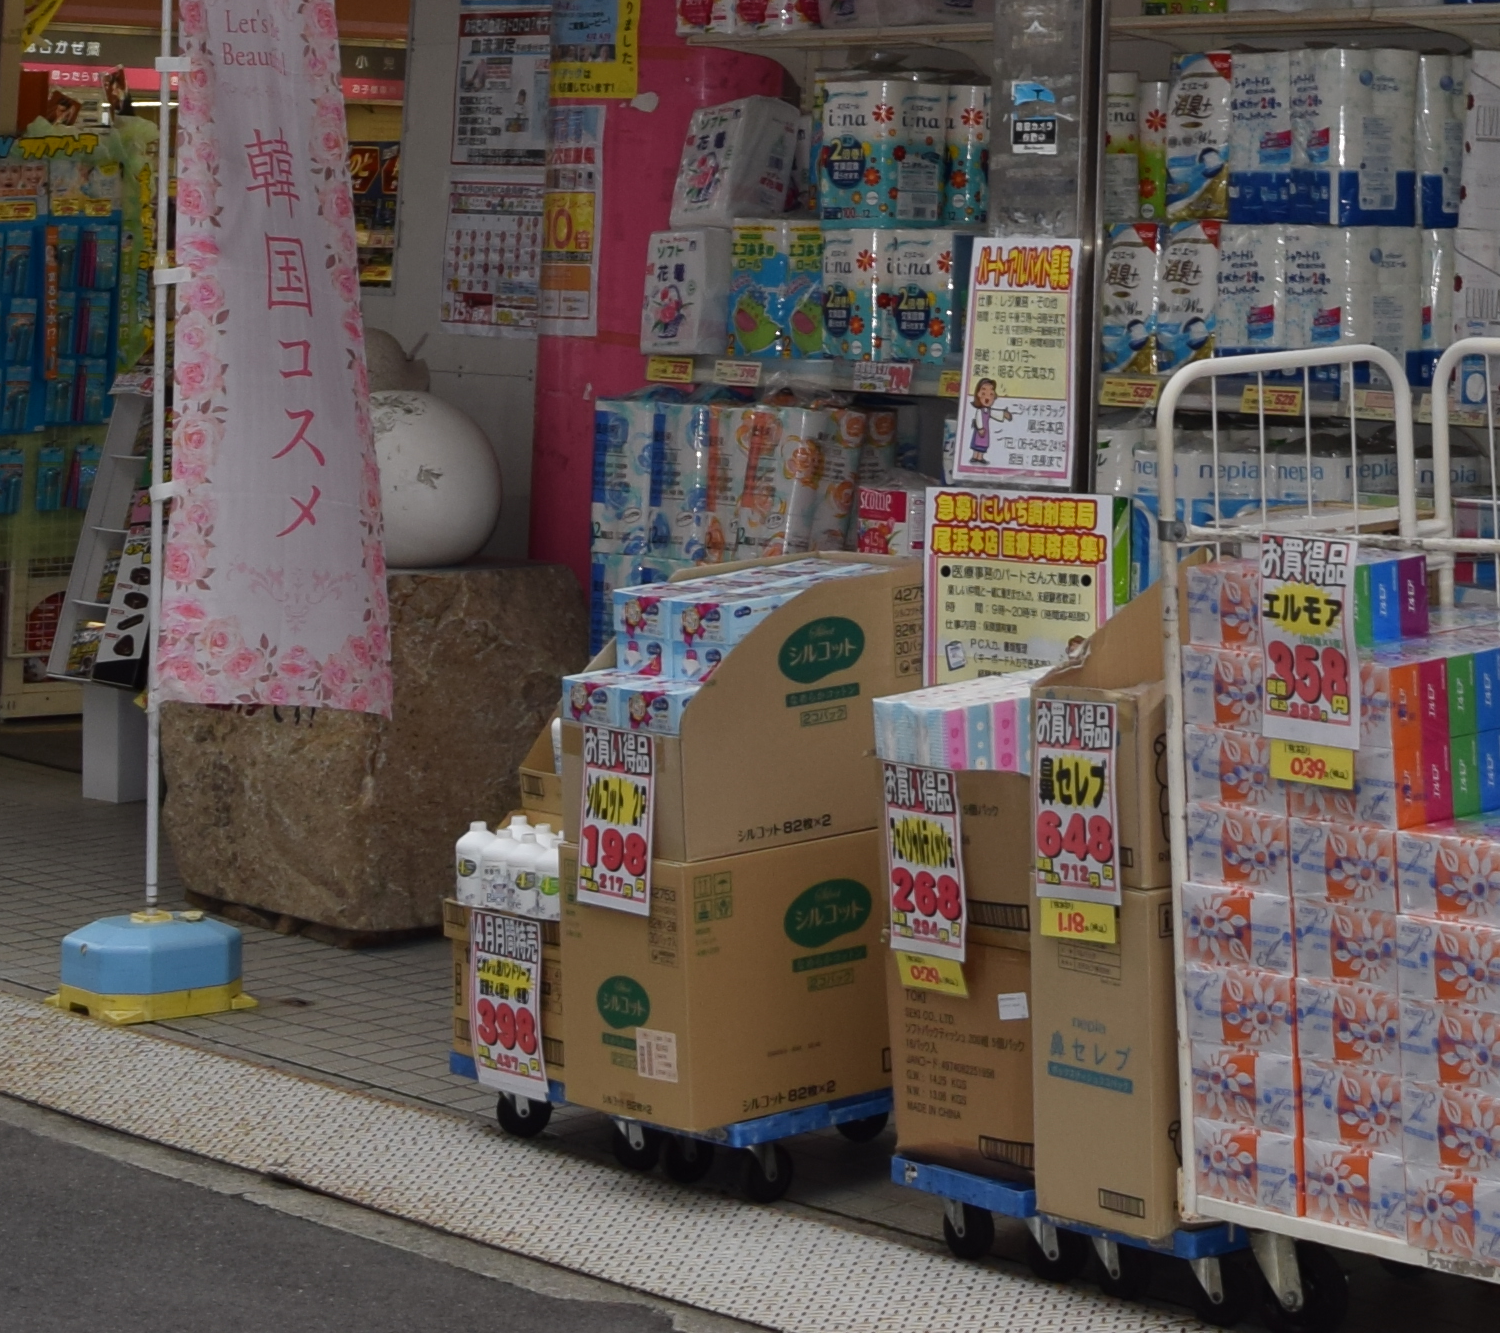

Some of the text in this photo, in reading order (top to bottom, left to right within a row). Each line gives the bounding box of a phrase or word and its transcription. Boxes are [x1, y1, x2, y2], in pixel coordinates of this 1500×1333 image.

[225, 9, 268, 33] Let's
[244, 128, 327, 538] 韓国コスメ
[1261, 536, 1349, 588] お買得品
[1262, 592, 1344, 628] エルモア
[787, 638, 857, 666] シルコット
[1267, 639, 1349, 706] 358
[583, 728, 651, 775] お買い得品
[1036, 701, 1112, 750] お買い得品
[884, 763, 954, 815] お買い得品
[1038, 755, 1108, 810] 鼻セレブ
[582, 824, 648, 877] 198
[1036, 810, 1114, 863] 648
[793, 901, 865, 930] シルコット
[890, 866, 961, 921] 268
[475, 997, 538, 1055] 398
[602, 994, 646, 1016] シルコット
